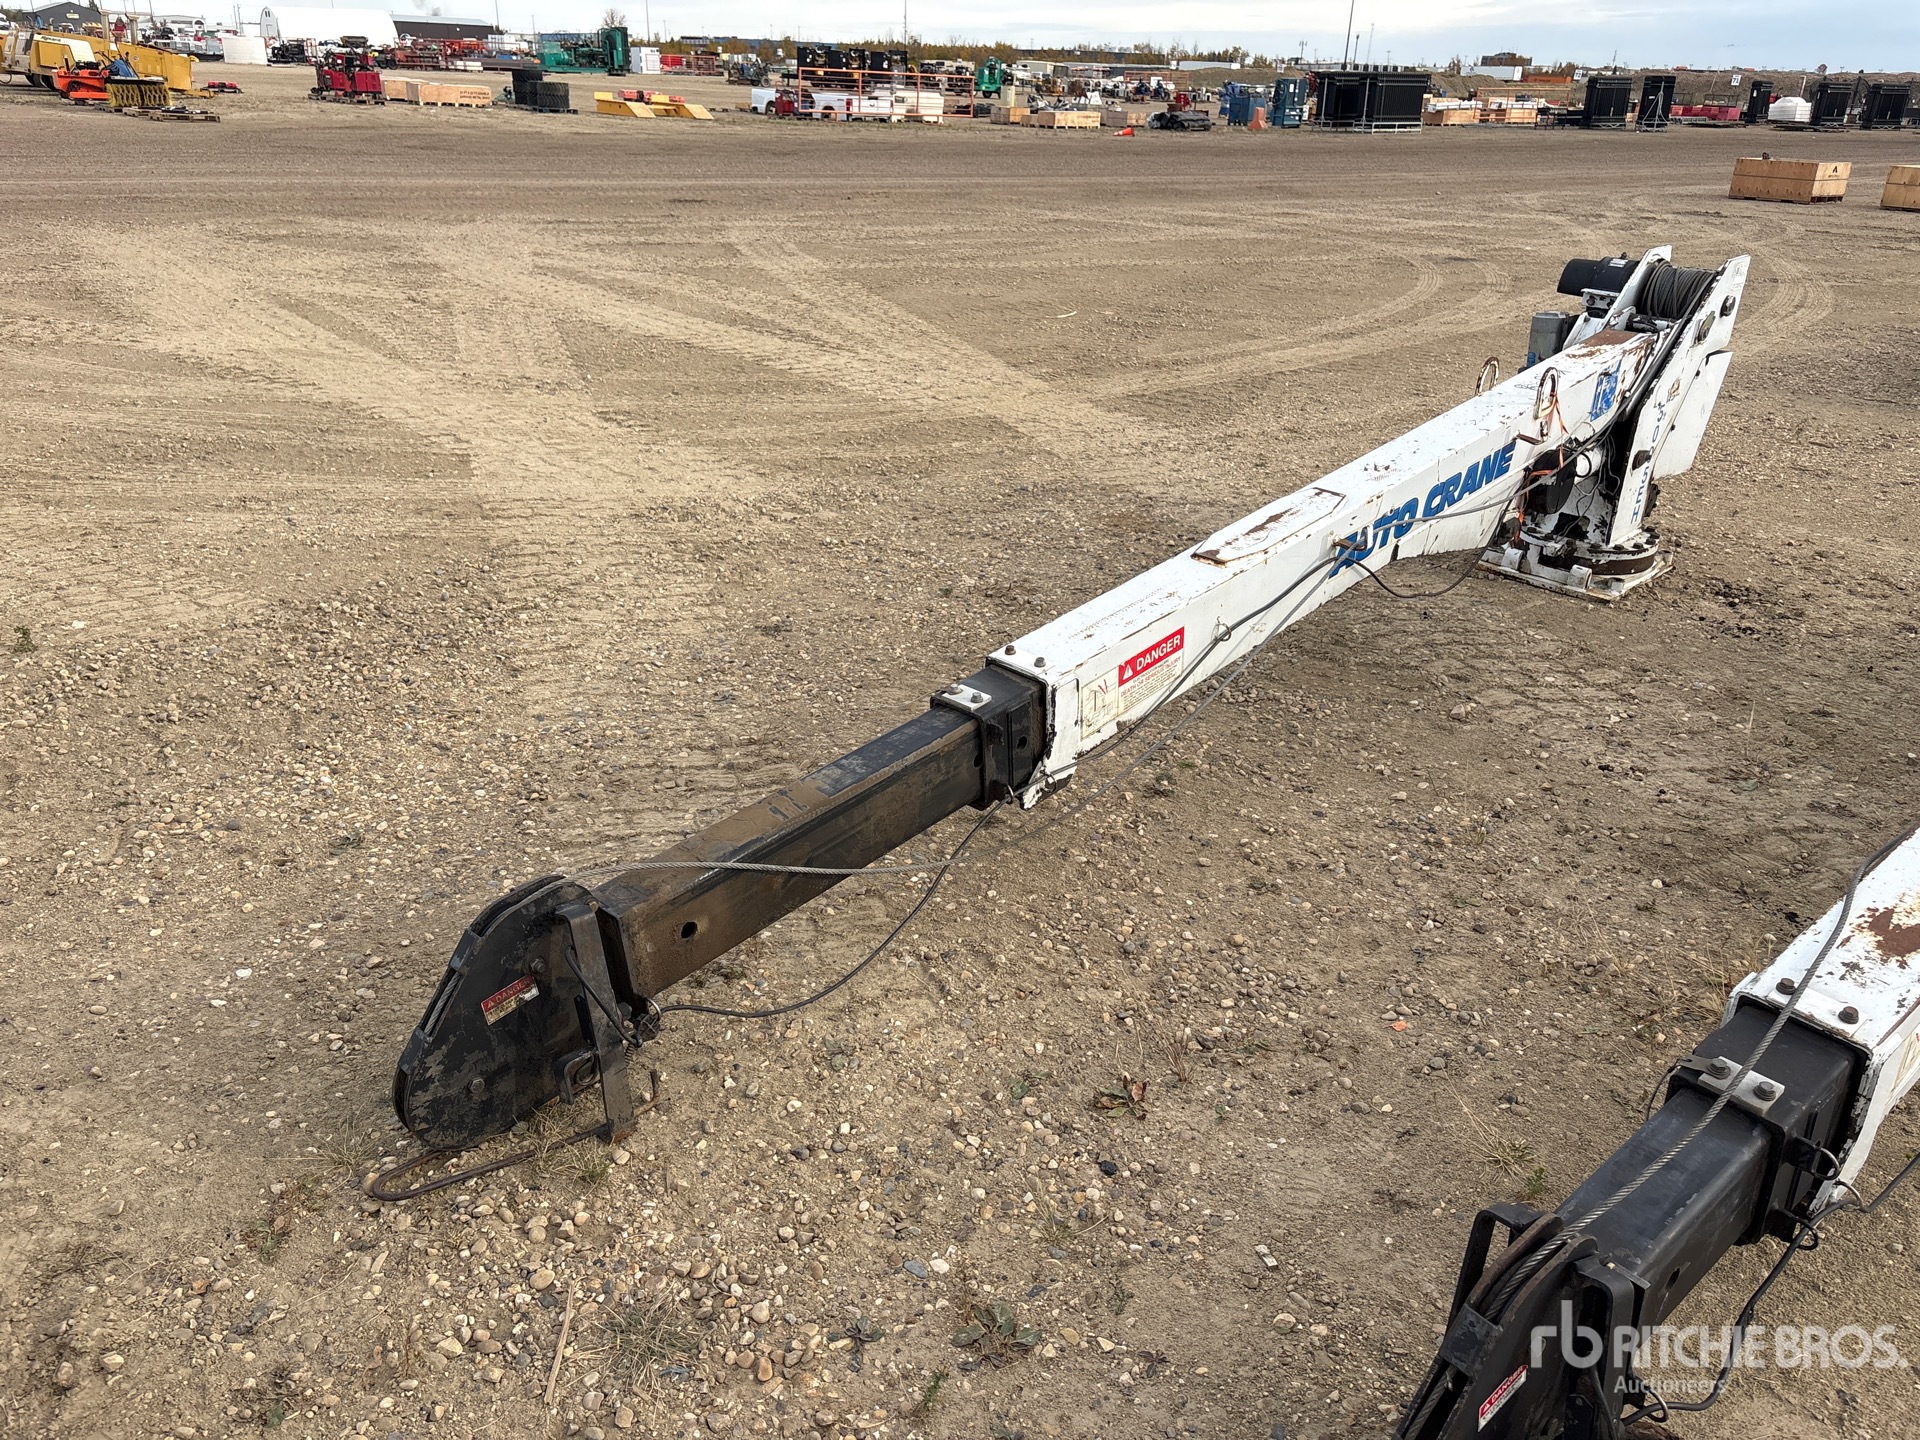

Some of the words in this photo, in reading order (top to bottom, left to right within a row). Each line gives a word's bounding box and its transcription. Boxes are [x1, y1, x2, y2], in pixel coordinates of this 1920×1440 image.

[1328, 497, 1419, 579] AUTO
[1422, 441, 1516, 520] CRANE
[1136, 635, 1180, 671] DANGER
[1492, 1366, 1523, 1403] DANGER
